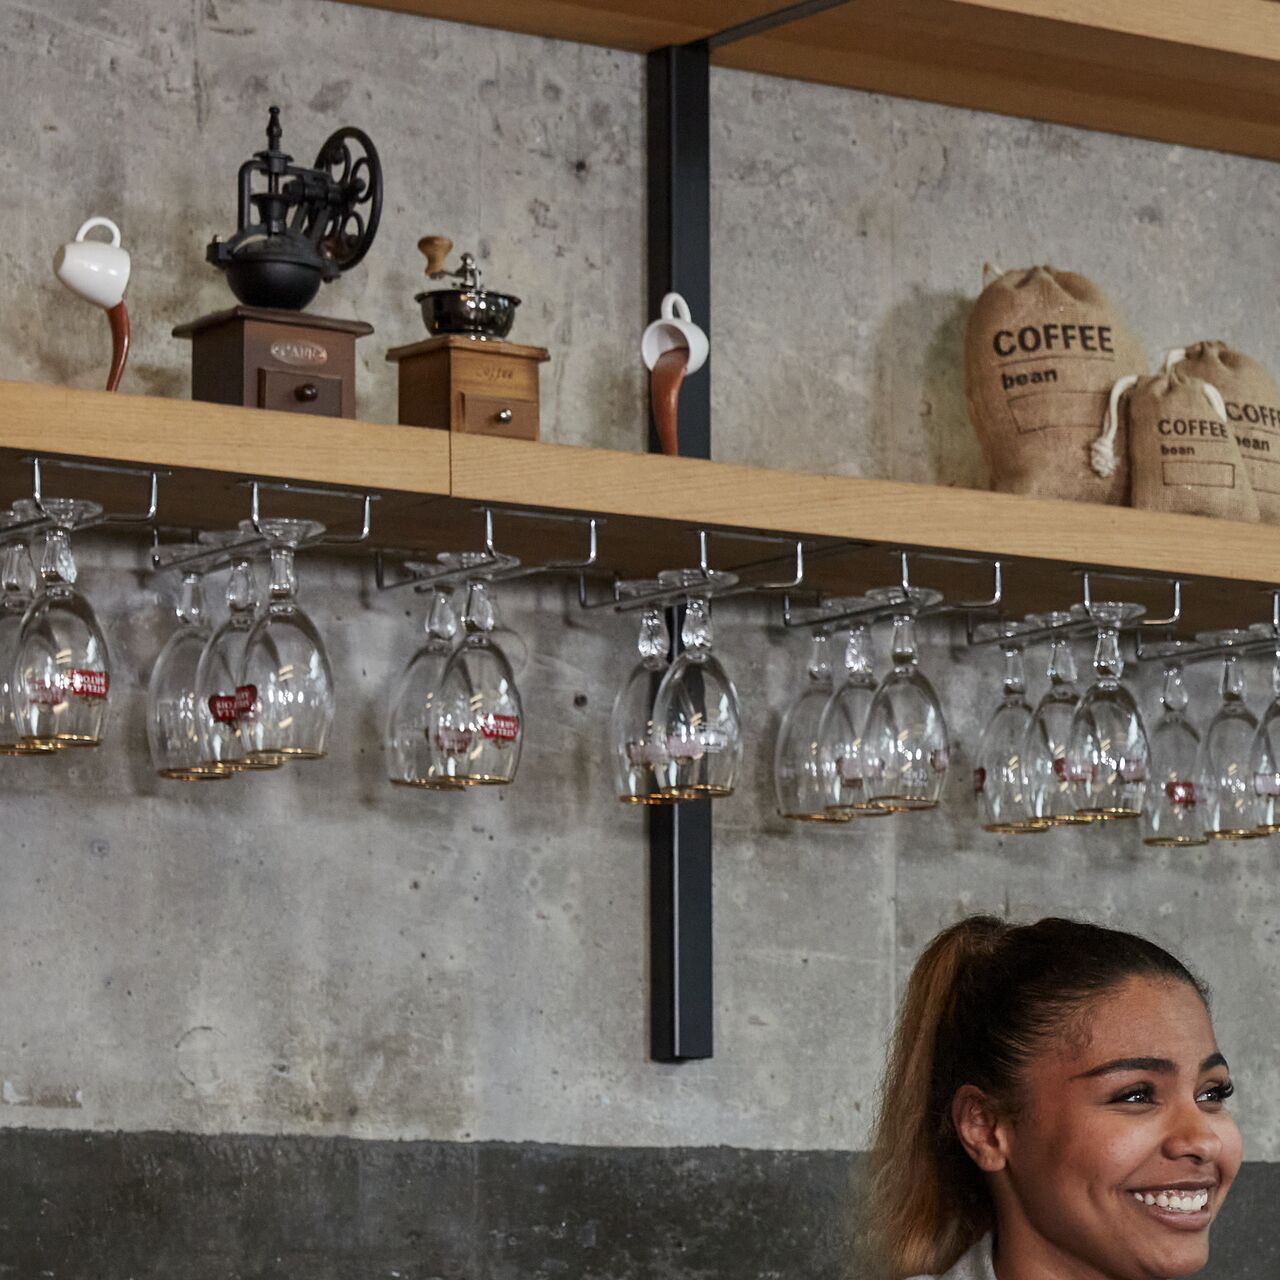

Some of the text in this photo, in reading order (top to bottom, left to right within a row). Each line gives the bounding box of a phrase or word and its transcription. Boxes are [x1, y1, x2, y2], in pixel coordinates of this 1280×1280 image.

[993, 324, 1114, 357] COFFEE
[1001, 368, 1058, 391] bean
[1158, 419, 1229, 439] COFFEE
[1160, 443, 1196, 456] bean
